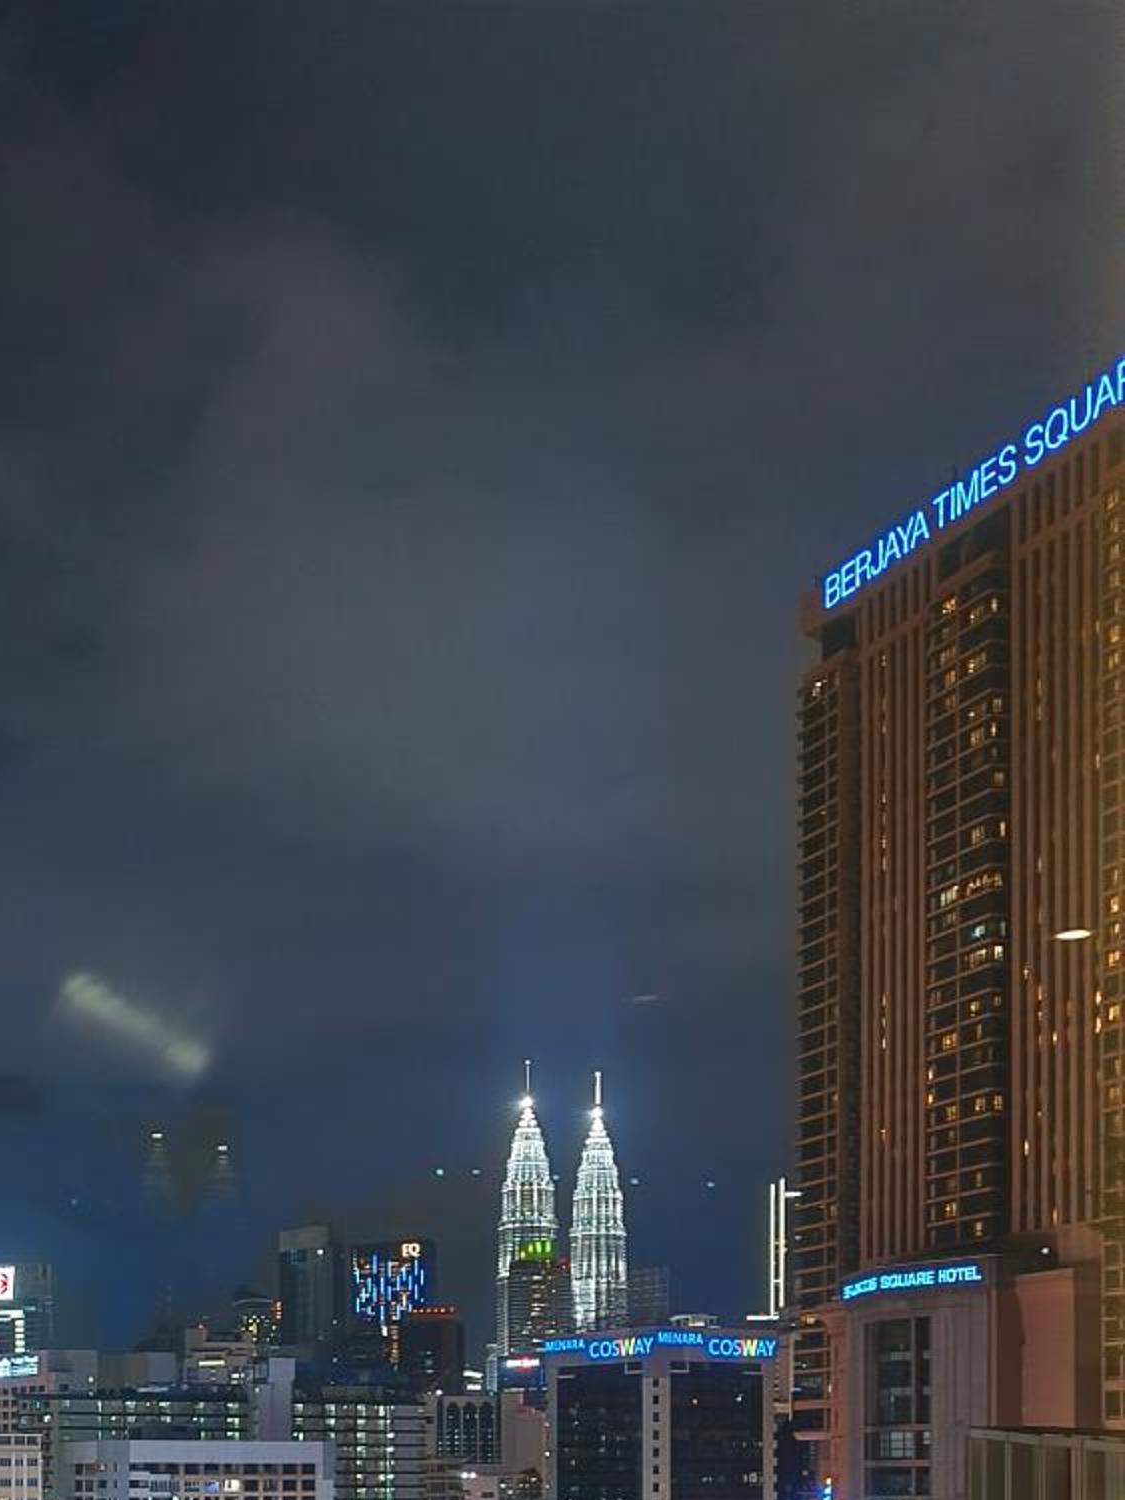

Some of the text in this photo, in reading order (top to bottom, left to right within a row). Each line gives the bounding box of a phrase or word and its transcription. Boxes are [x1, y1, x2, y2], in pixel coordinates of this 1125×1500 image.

[824, 510, 930, 609] BERJAYA
[931, 444, 1017, 529] TIMES
[401, 1243, 421, 1258] EQ
[879, 1271, 935, 1289] SQUARE
[937, 1265, 982, 1284] HOTEL
[588, 1337, 654, 1358] COSWAY
[657, 1330, 776, 1357] MENARA COSWAY
